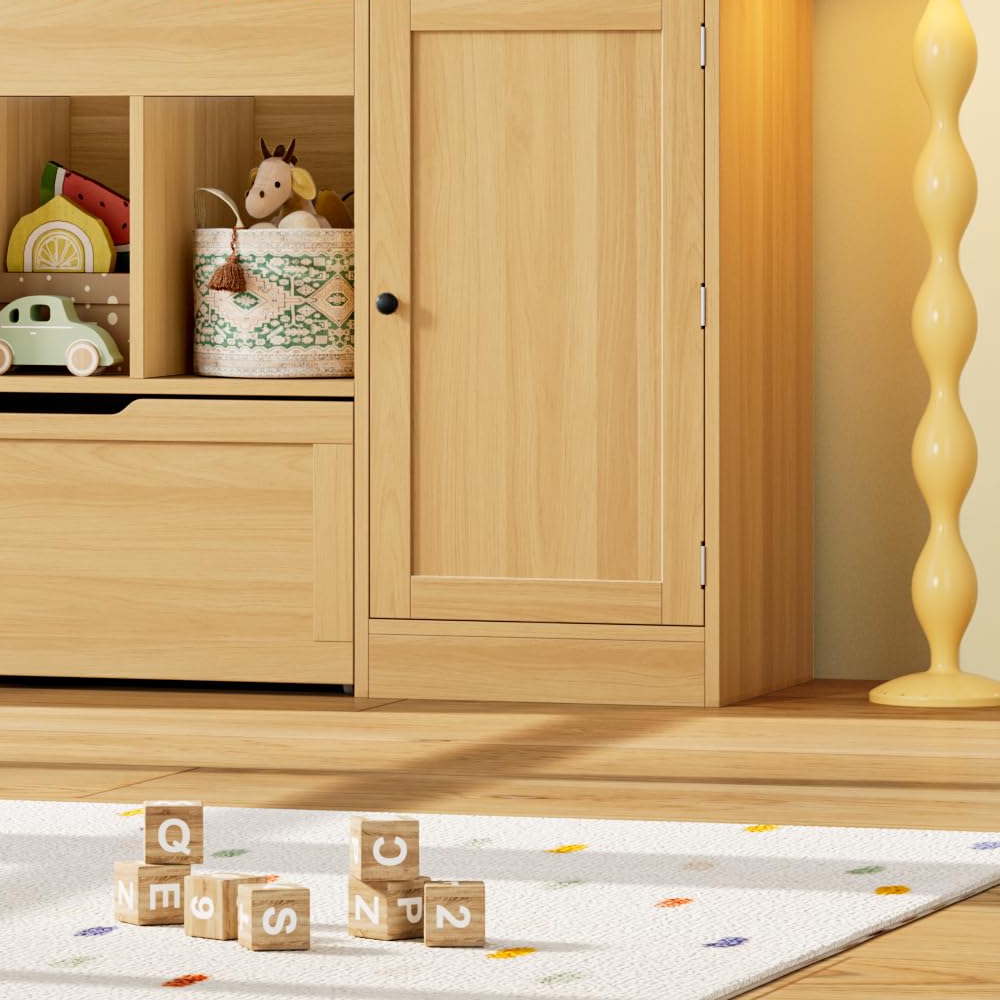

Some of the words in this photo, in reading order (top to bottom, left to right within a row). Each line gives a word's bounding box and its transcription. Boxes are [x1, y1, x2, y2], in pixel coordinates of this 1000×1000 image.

[158, 818, 191, 855] Q
[372, 836, 408, 866] C
[149, 883, 181, 910] E
[397, 896, 423, 924] P
[262, 906, 297, 936] S
[436, 904, 471, 929] 2
